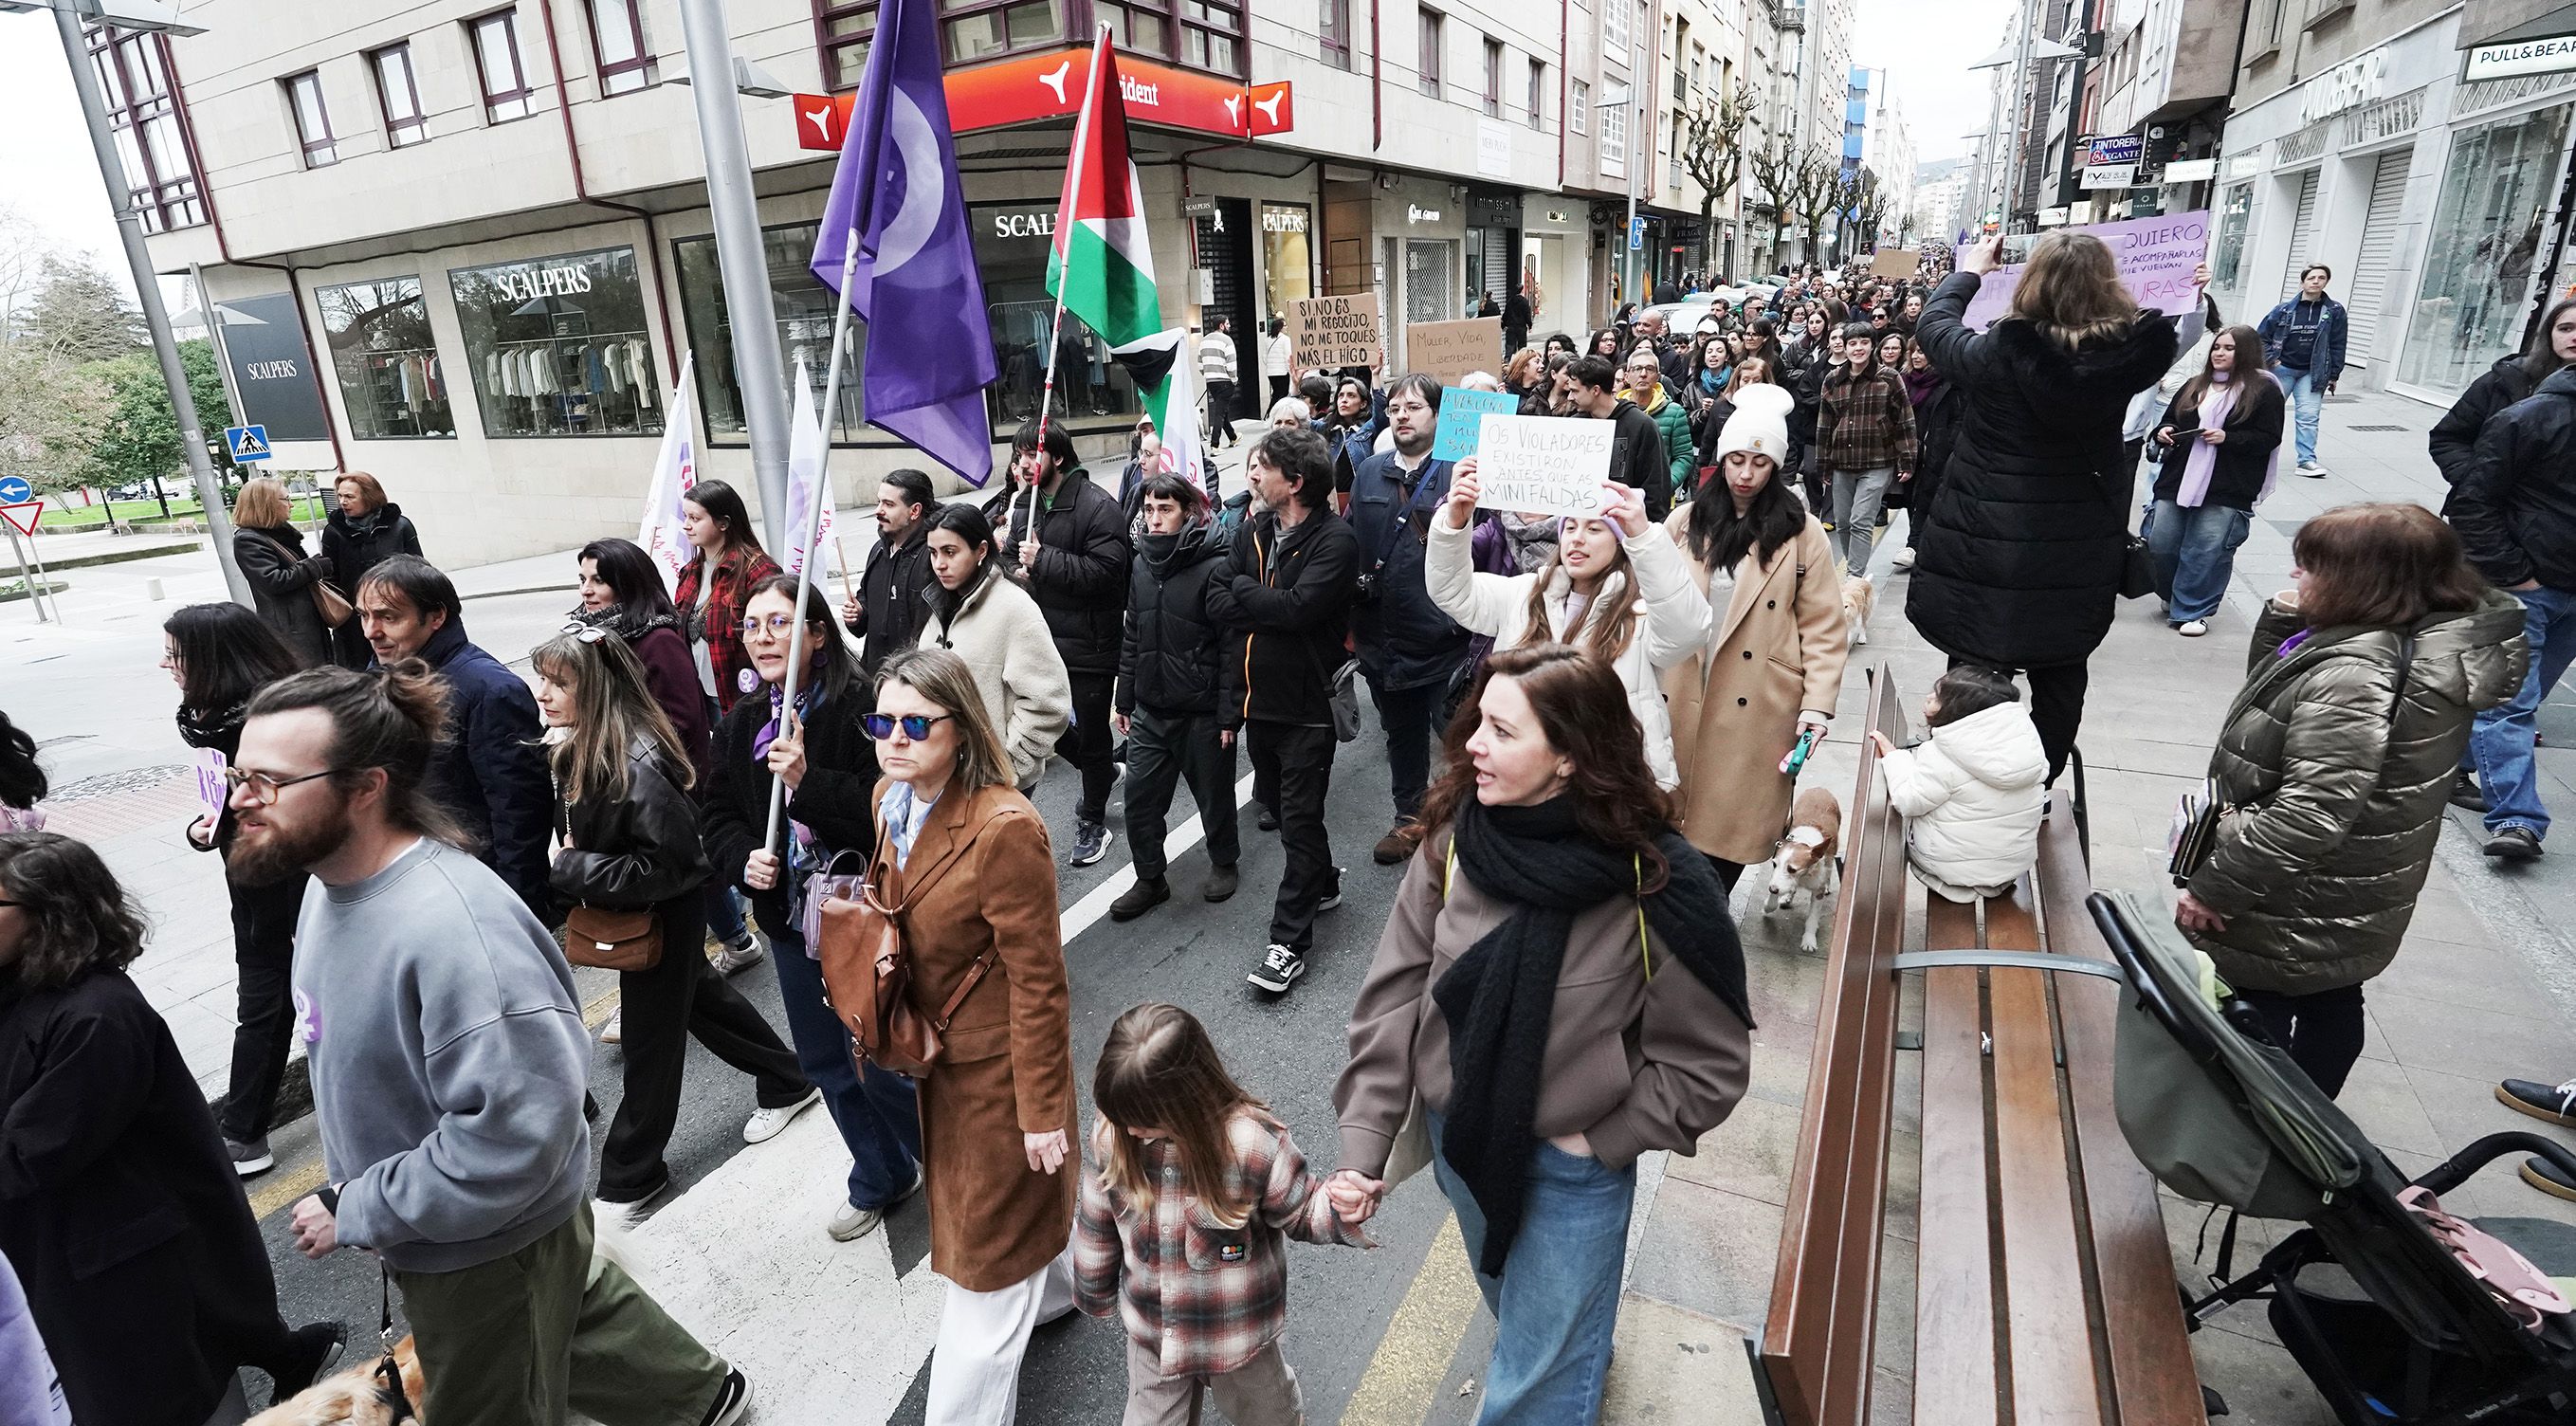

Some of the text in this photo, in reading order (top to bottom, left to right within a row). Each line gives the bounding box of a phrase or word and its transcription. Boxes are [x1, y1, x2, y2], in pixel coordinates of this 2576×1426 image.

[1119, 74, 1160, 106] ident
[2095, 136, 2143, 151] TINTORERIA
[1185, 202, 1211, 211] SCALPERS
[996, 213, 1059, 238] SCAL
[2141, 263, 2182, 272] VUELVAN
[497, 264, 592, 302] SCALPERS
[2132, 276, 2194, 303] URAS
[1305, 317, 1317, 331] MI
[1300, 333, 1315, 347] NO
[1334, 329, 1377, 344] TOQUES
[1324, 348, 1336, 365] EL
[247, 359, 298, 380] SCALPERS
[1547, 470, 1570, 484] QUE
[1578, 474, 1594, 484] AS
